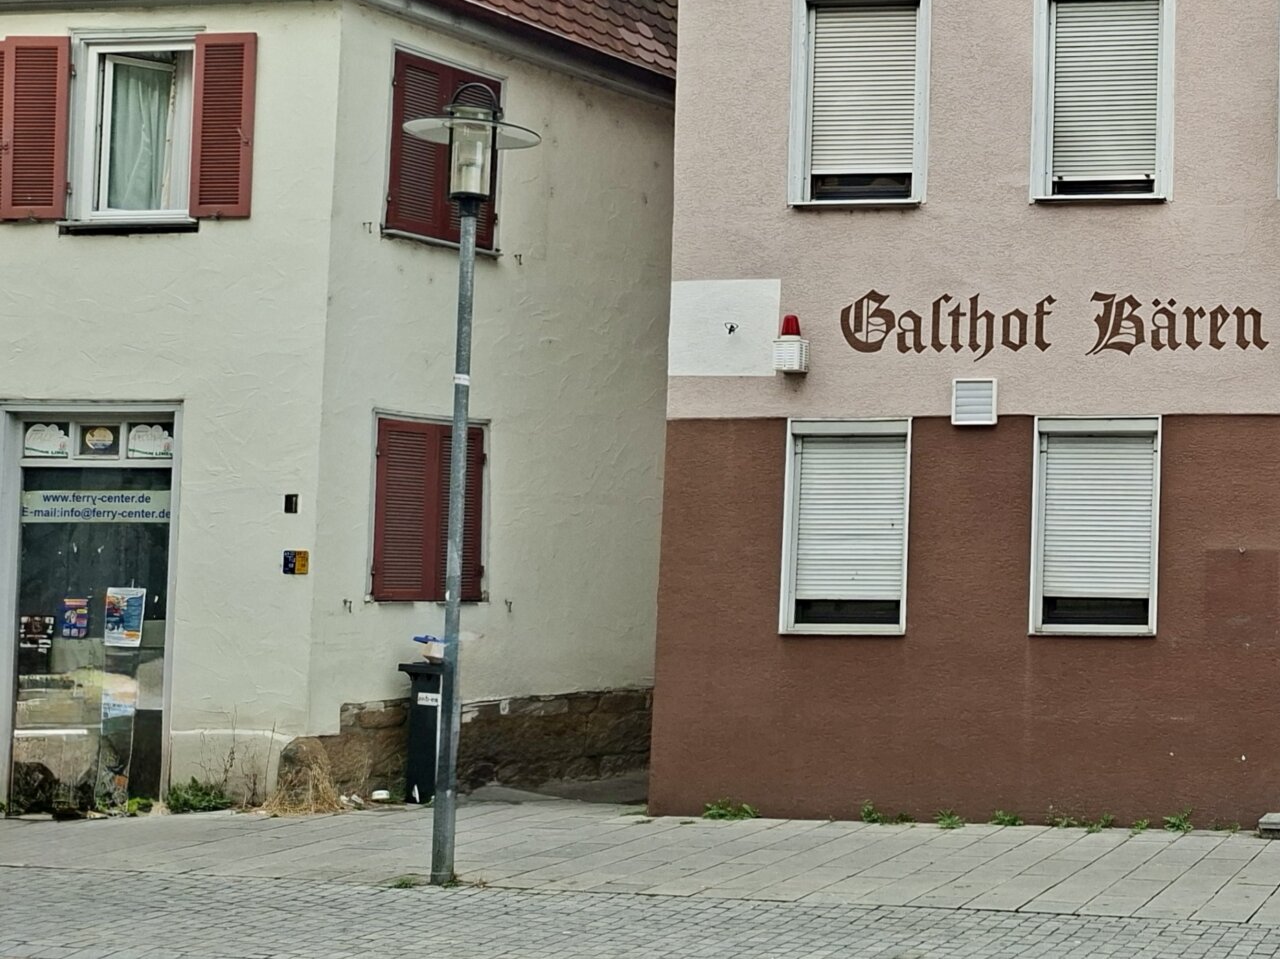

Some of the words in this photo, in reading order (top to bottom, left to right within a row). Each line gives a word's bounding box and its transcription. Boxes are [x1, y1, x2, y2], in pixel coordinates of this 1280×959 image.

[1085, 291, 1269, 356] Bären
[42, 492, 151, 506] www.ferry-center.de
[22, 506, 171, 520] E-mail:info@ferry-center.de
